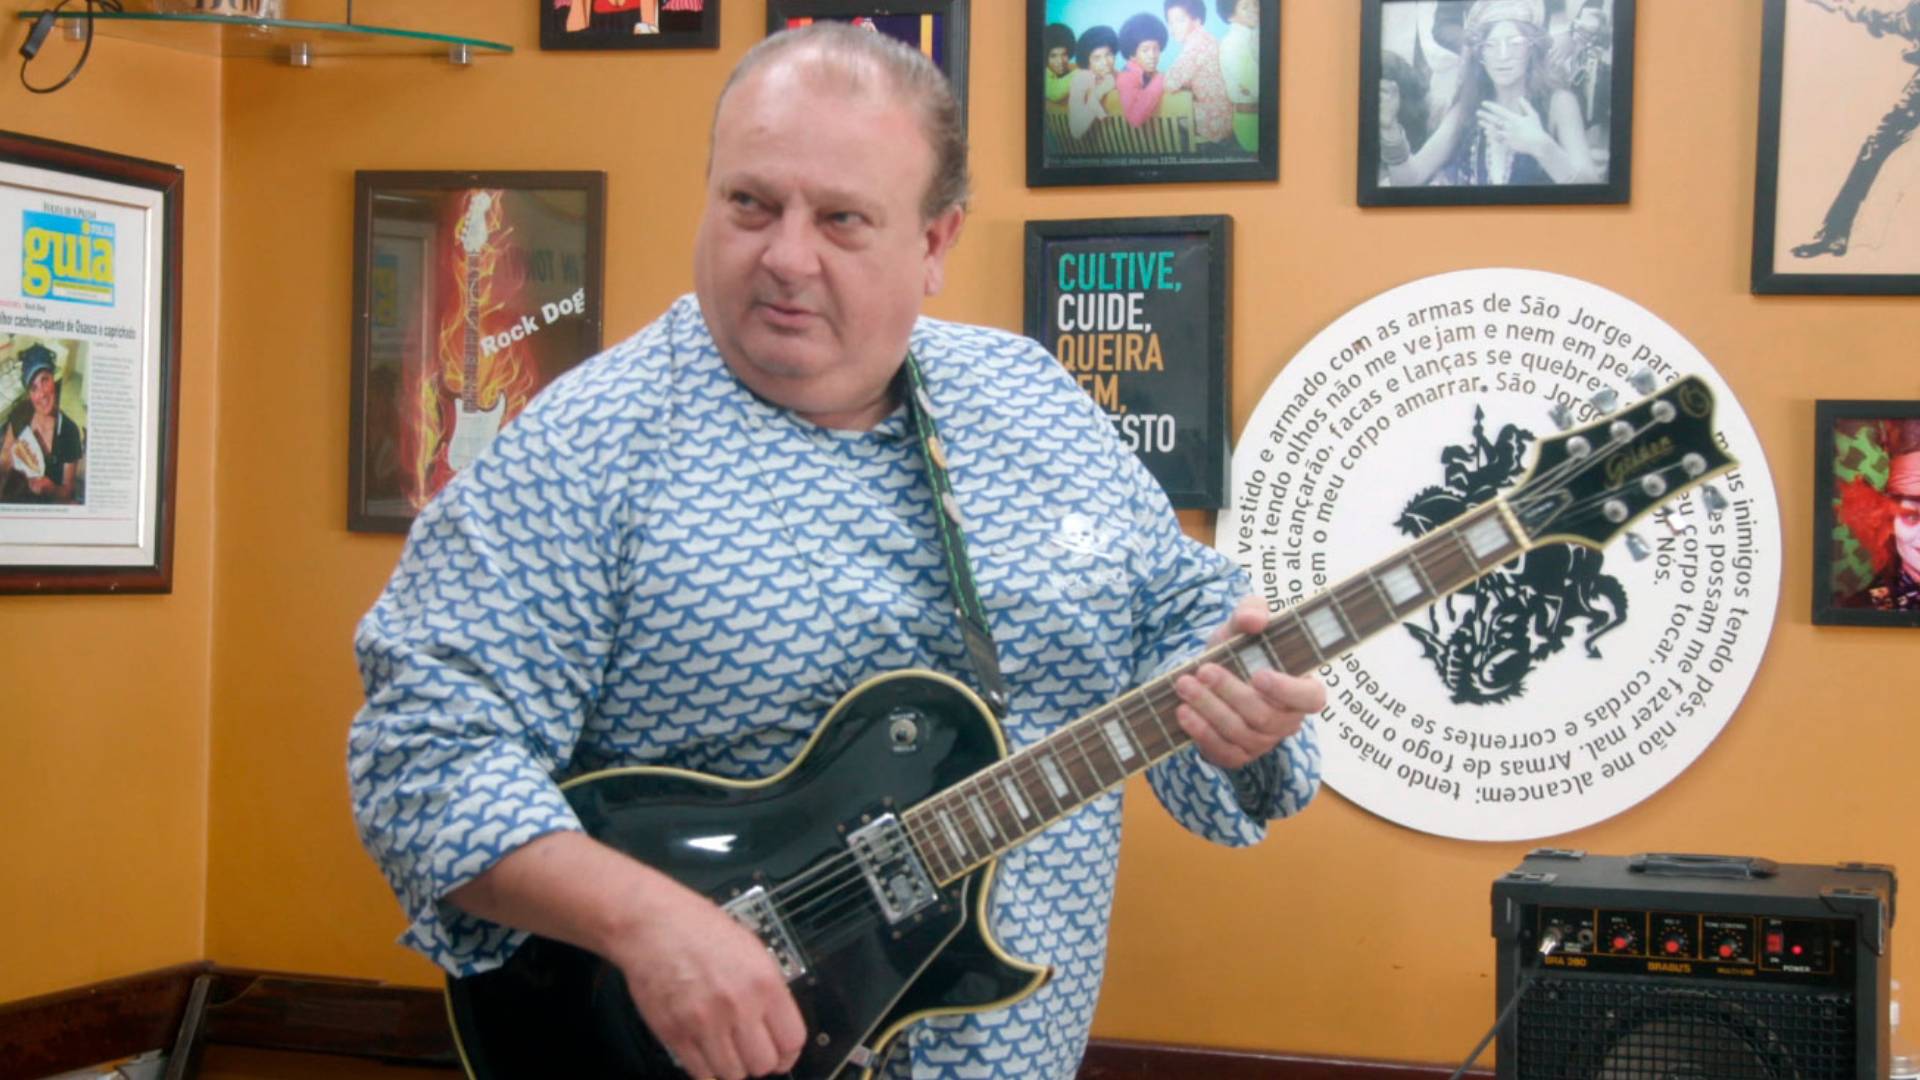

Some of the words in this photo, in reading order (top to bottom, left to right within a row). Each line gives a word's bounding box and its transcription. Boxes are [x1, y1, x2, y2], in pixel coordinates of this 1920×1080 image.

[22, 218, 115, 296] guia
[1058, 251, 1182, 292] CULTIVE,
[1057, 293, 1151, 333] CUIDE,
[1407, 298, 1475, 328] armas
[1482, 293, 1511, 313] de
[1520, 295, 1560, 319] São
[481, 315, 539, 358] Rock
[541, 287, 585, 325] Dog
[1376, 319, 1401, 341] as
[1403, 325, 1476, 355] vejam
[1484, 323, 1498, 339] e
[1506, 323, 1555, 345] nem
[1568, 308, 1632, 348] Jorge
[1057, 333, 1164, 372] QUEIRA
[1329, 334, 1373, 371] com
[1364, 350, 1397, 377] me
[1487, 349, 1512, 365] se
[1562, 335, 1596, 360] em
[1386, 377, 1399, 393] e
[1402, 350, 1478, 384] lanças
[1496, 372, 1536, 394] São
[1075, 374, 1127, 414] EM,
[1269, 371, 1328, 444] armado
[1326, 374, 1362, 409] não
[1328, 388, 1383, 440] facas
[1286, 406, 1329, 465] olhos
[1340, 414, 1390, 472] corpo
[1260, 448, 1274, 463] e
[1238, 469, 1267, 554] vestido
[1260, 471, 1293, 536] tendo
[1282, 446, 1334, 570] alcançarão,
[1317, 474, 1345, 523] meu
[1313, 529, 1328, 544] o
[1732, 498, 1760, 598] inimigos
[1654, 536, 1677, 585] Nós.
[1677, 525, 1698, 594] corpo
[1697, 544, 1727, 634] possam
[1649, 602, 1694, 665] tocar,
[1708, 607, 1750, 674] tendo
[1678, 638, 1705, 674] me
[1338, 689, 1381, 731] meu
[1584, 670, 1652, 728] cordas
[1630, 677, 1684, 731] fazer
[1675, 674, 1715, 718] pés,
[1382, 727, 1396, 742] o
[1411, 712, 1437, 735] se
[1443, 726, 1557, 750] correntes
[1564, 721, 1578, 737] e
[1638, 720, 1678, 755] não
[1339, 720, 1394, 771] mãos,
[1401, 737, 1454, 773] fogo
[1579, 725, 1628, 761] mal.
[1462, 757, 1492, 779] de
[1500, 750, 1571, 776] Armas
[1602, 752, 1636, 778] me
[1397, 763, 1461, 801] tendo
[1475, 770, 1593, 804] alcancem;
